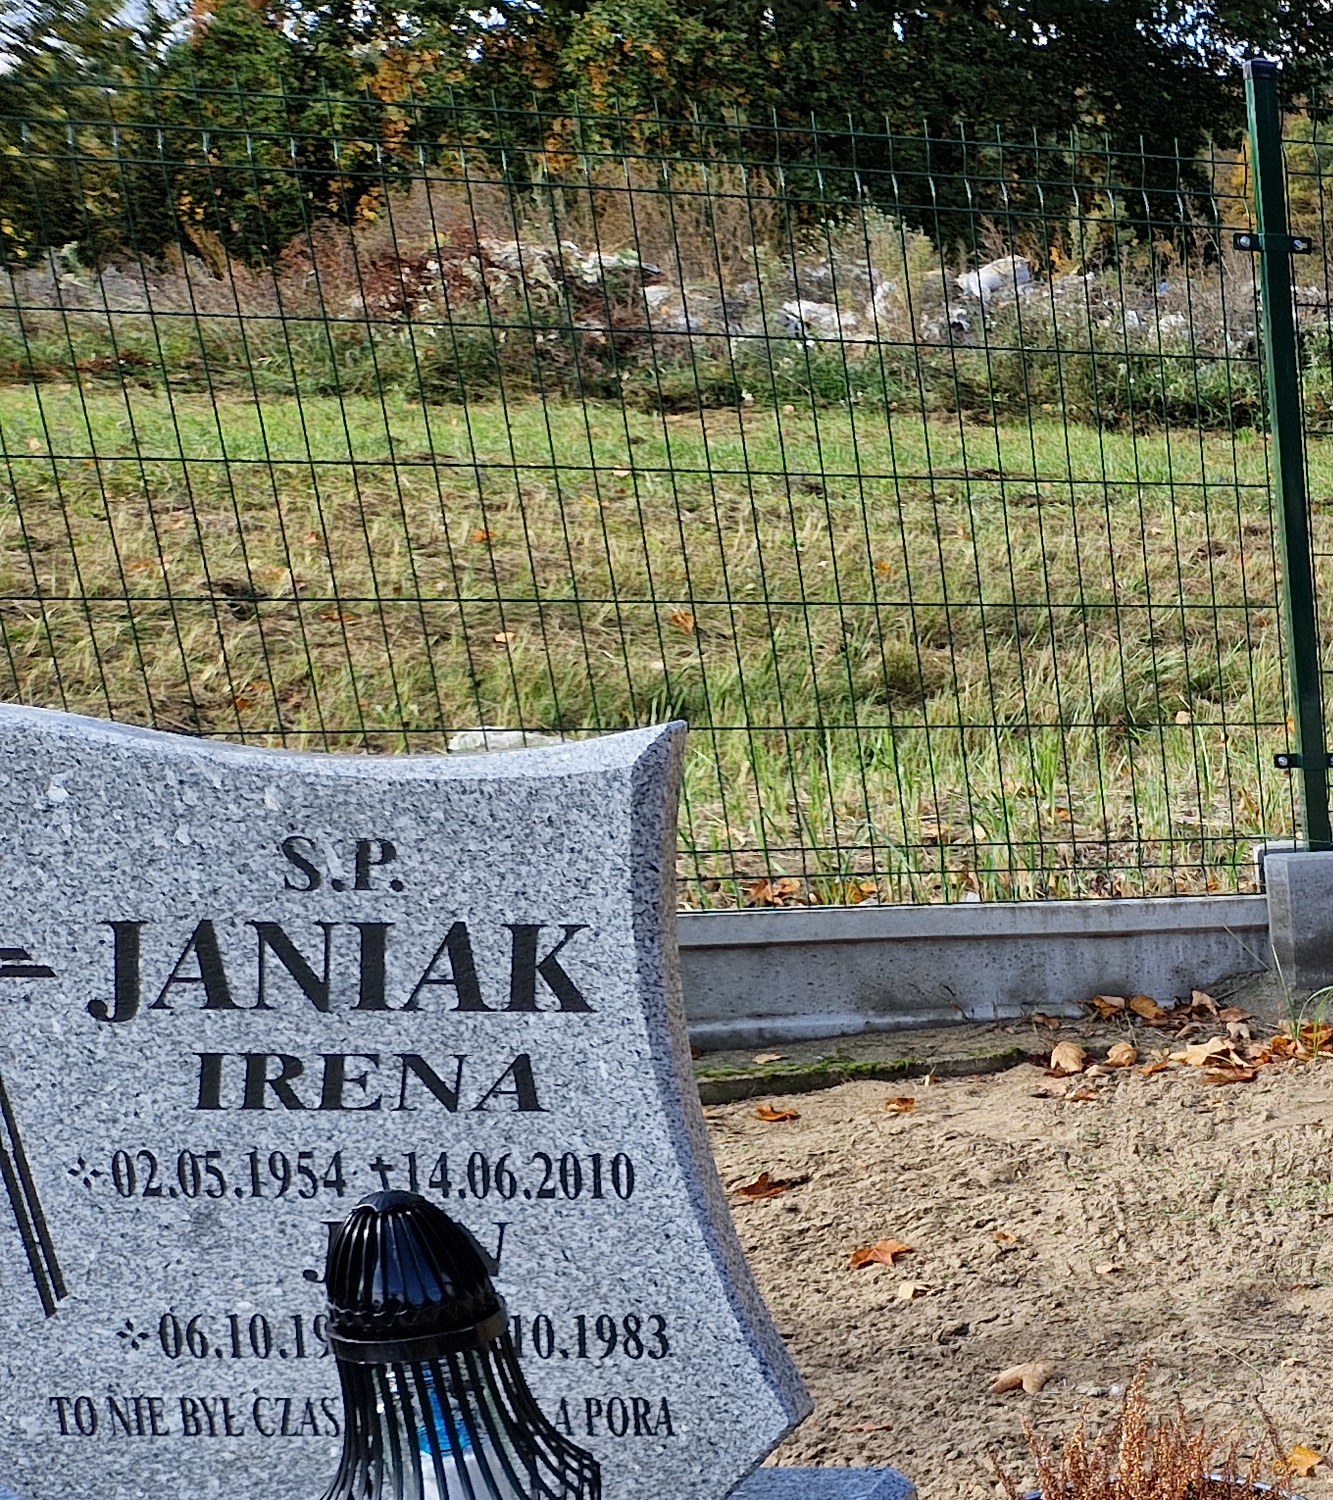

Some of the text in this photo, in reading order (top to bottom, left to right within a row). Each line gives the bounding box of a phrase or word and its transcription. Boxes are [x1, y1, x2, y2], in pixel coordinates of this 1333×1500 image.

[87, 919, 601, 1022] JANIAK
[192, 1051, 550, 1113] IRENA
[49, 1395, 98, 1437] TO
[108, 1394, 170, 1438] NIE
[180, 1394, 246, 1438] BYŁ
[583, 1396, 677, 1438] PORA
